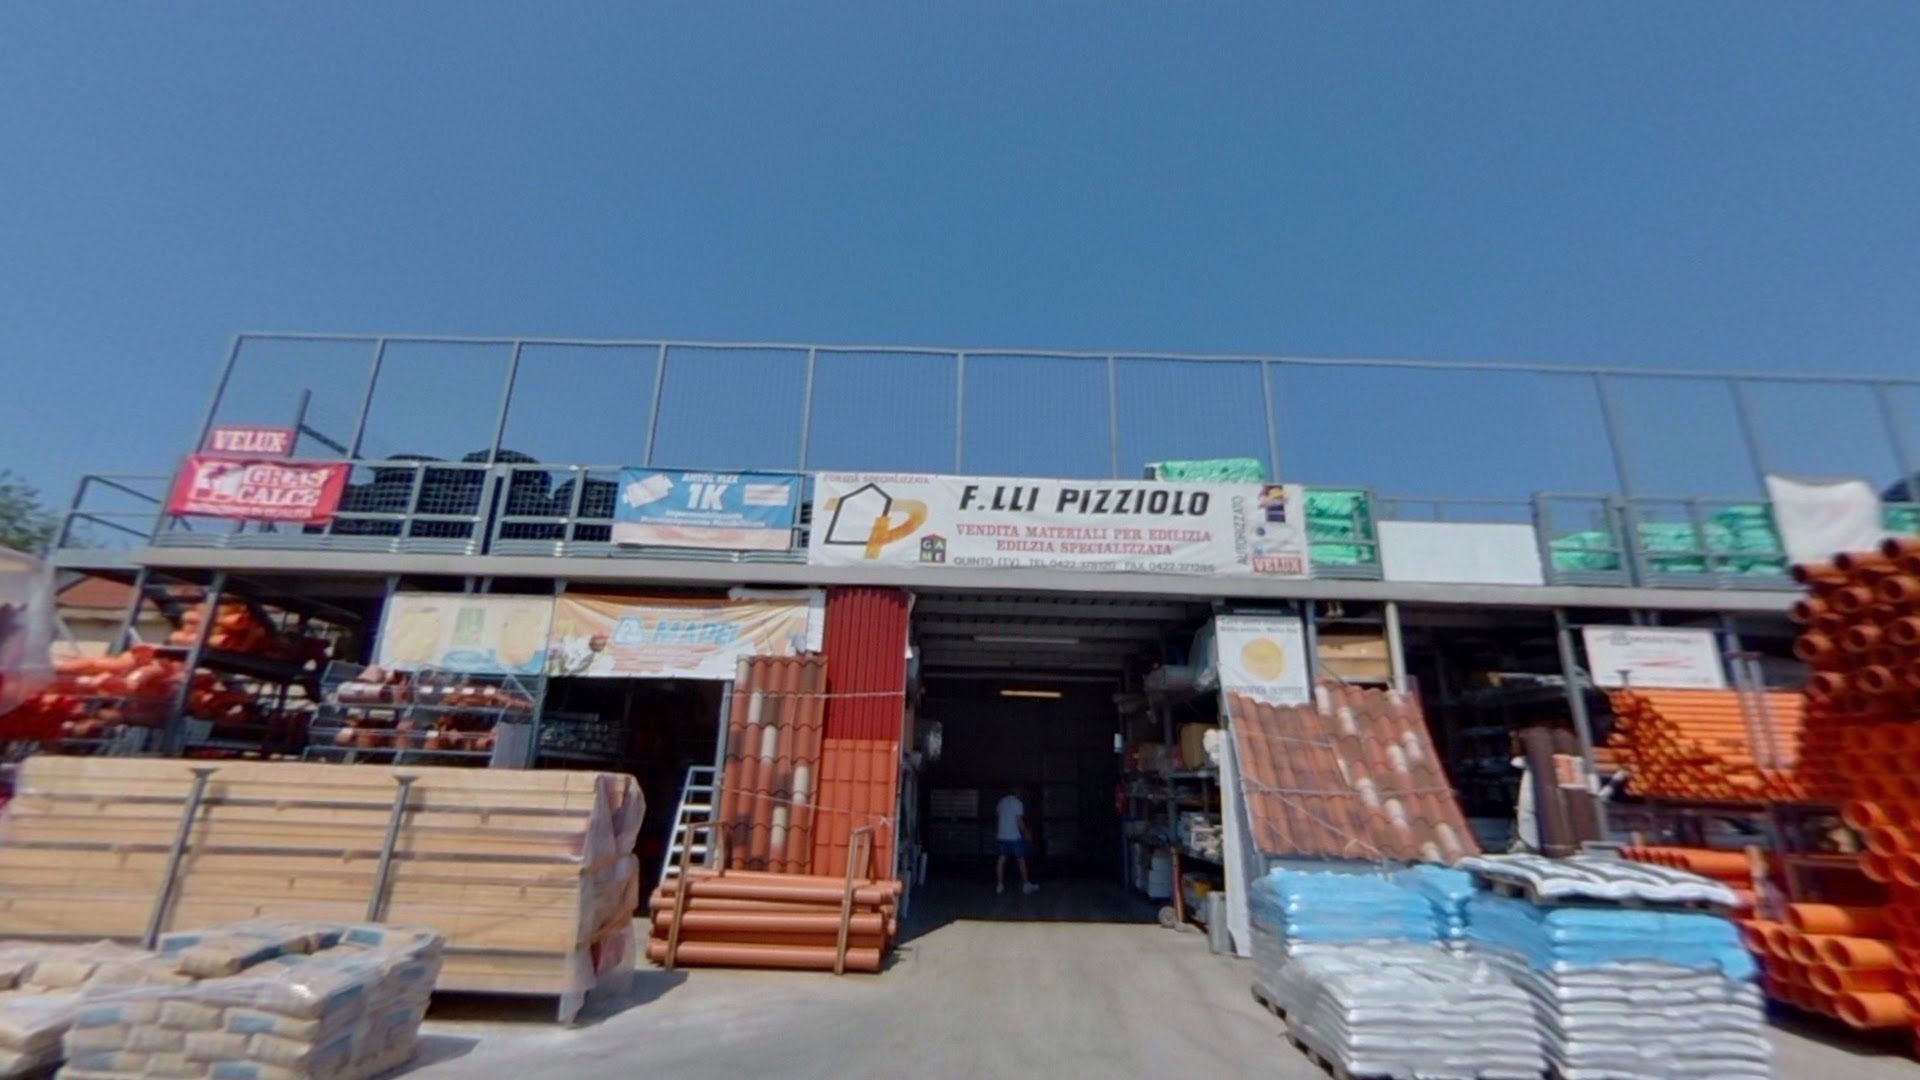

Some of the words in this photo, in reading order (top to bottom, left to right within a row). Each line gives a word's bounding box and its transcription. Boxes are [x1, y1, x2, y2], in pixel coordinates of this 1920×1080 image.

[213, 429, 288, 452] VELUX
[237, 485, 323, 508] CALCE
[687, 483, 729, 511] 1K
[958, 485, 1040, 512] F.LLI
[1055, 488, 1210, 516] PIZZIOLO
[956, 523, 1019, 537] VENDITA
[1026, 525, 1107, 540] MATERIALI
[1114, 527, 1142, 541] PER
[1149, 529, 1212, 543] EDILIZIA
[1060, 542, 1172, 555] SPECIALIZZATA
[953, 556, 995, 567] QUINTO
[1124, 562, 1145, 571] FAX
[1254, 558, 1301, 573] VELUX
